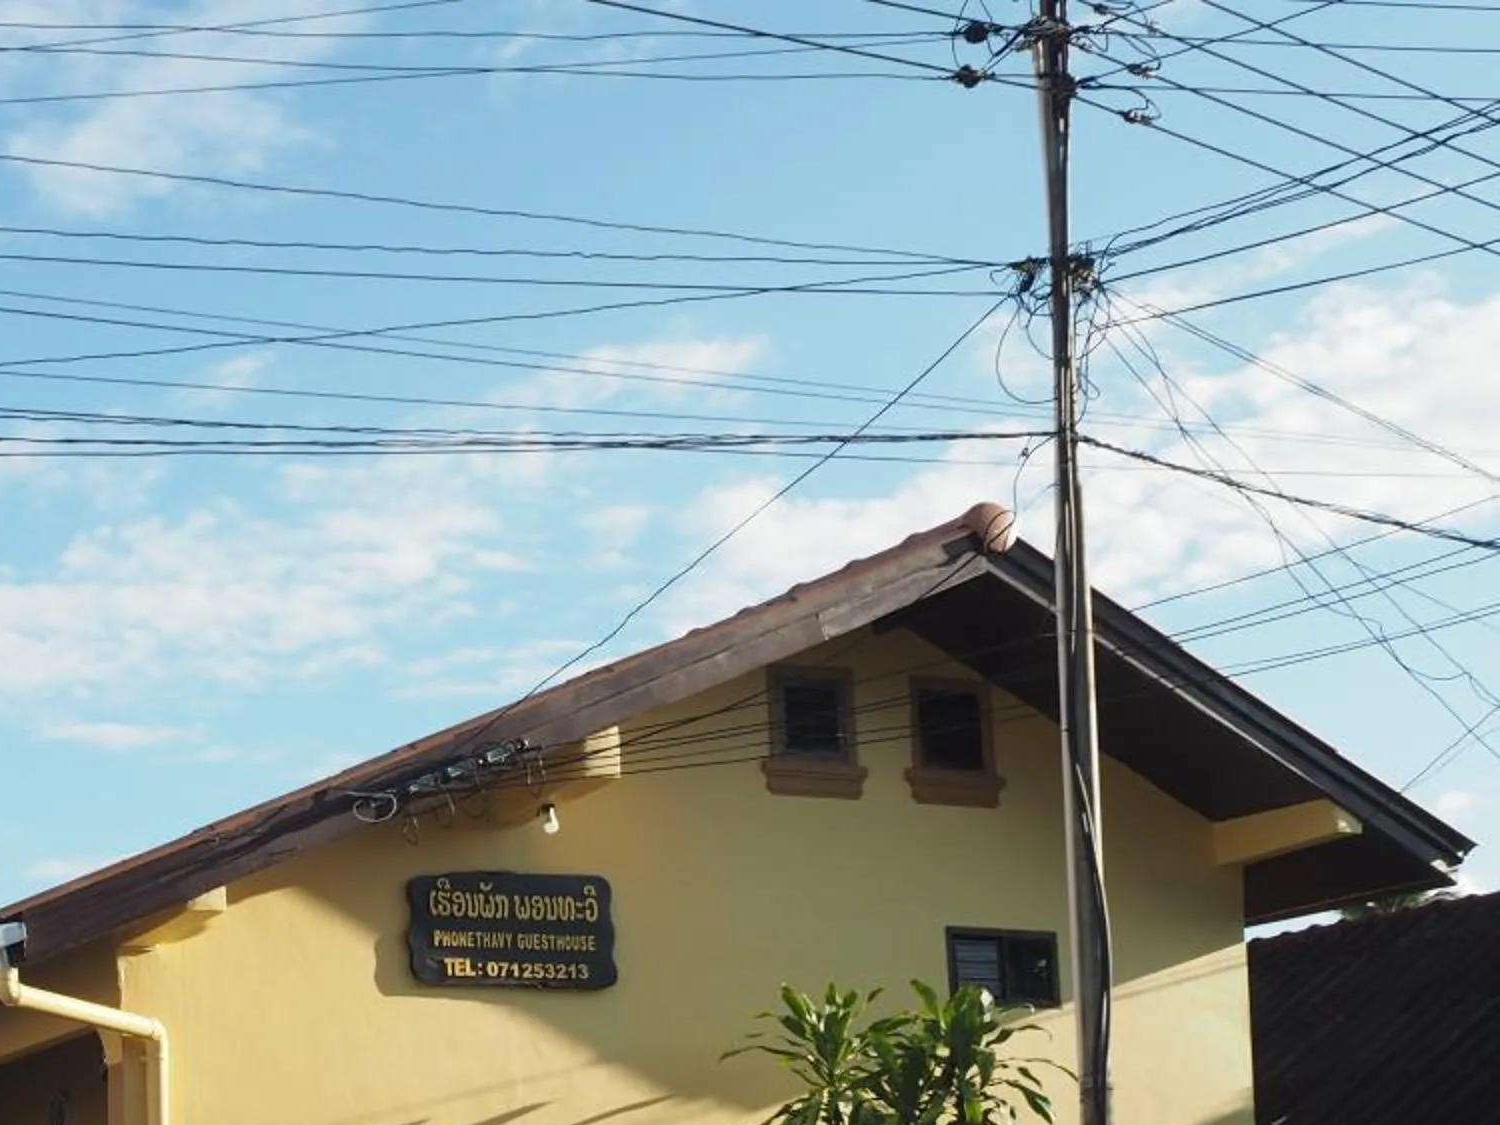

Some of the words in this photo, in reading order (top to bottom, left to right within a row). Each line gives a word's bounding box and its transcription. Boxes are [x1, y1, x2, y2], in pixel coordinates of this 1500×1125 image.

[433, 929, 513, 949] PHONETHAVY
[517, 932, 596, 952] GUESTHOUSE
[444, 957, 483, 977] TEL:
[487, 961, 589, 980] 071253213
